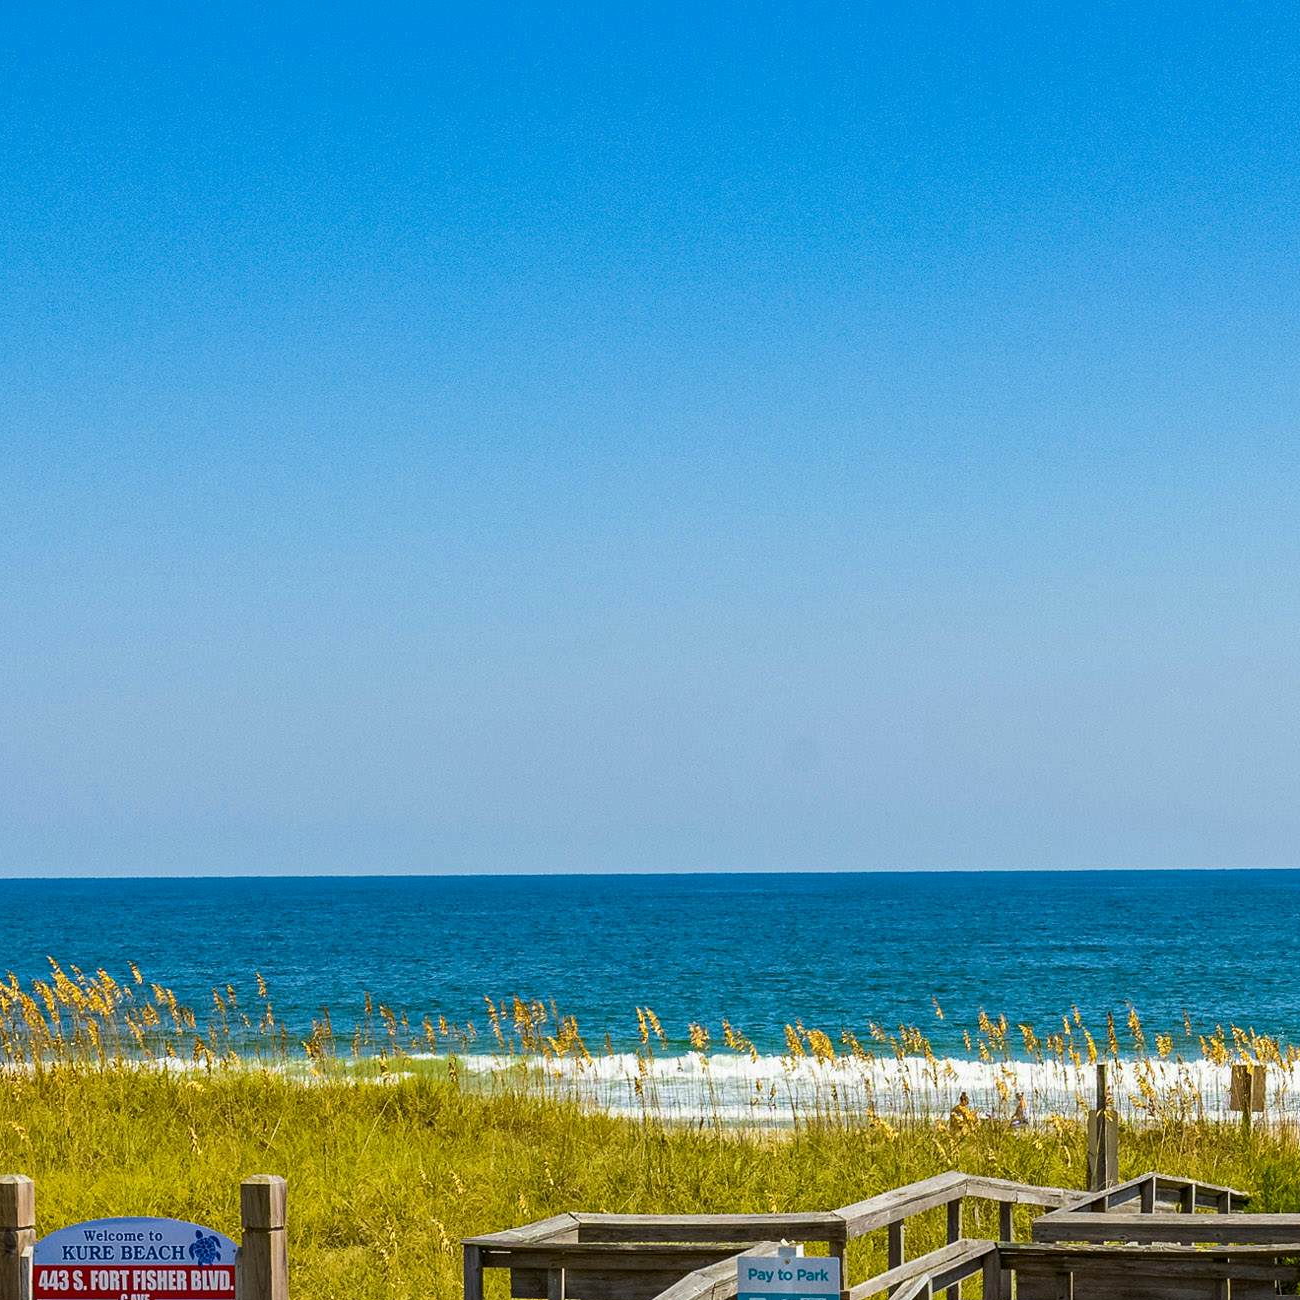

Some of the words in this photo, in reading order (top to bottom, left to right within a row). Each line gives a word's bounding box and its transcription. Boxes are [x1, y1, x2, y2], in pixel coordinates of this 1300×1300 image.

[84, 1230, 143, 1242] Welcome
[150, 1231, 163, 1242] to
[62, 1246, 114, 1260] KURE
[121, 1246, 186, 1260] BEACH
[38, 1270, 70, 1290] 443
[73, 1270, 88, 1290] S.
[90, 1270, 130, 1291] FORT
[132, 1270, 188, 1291] FISHER
[191, 1270, 234, 1291] BLVD.
[748, 1268, 774, 1283] Pay
[778, 1269, 793, 1281] to
[797, 1268, 828, 1282] Park
